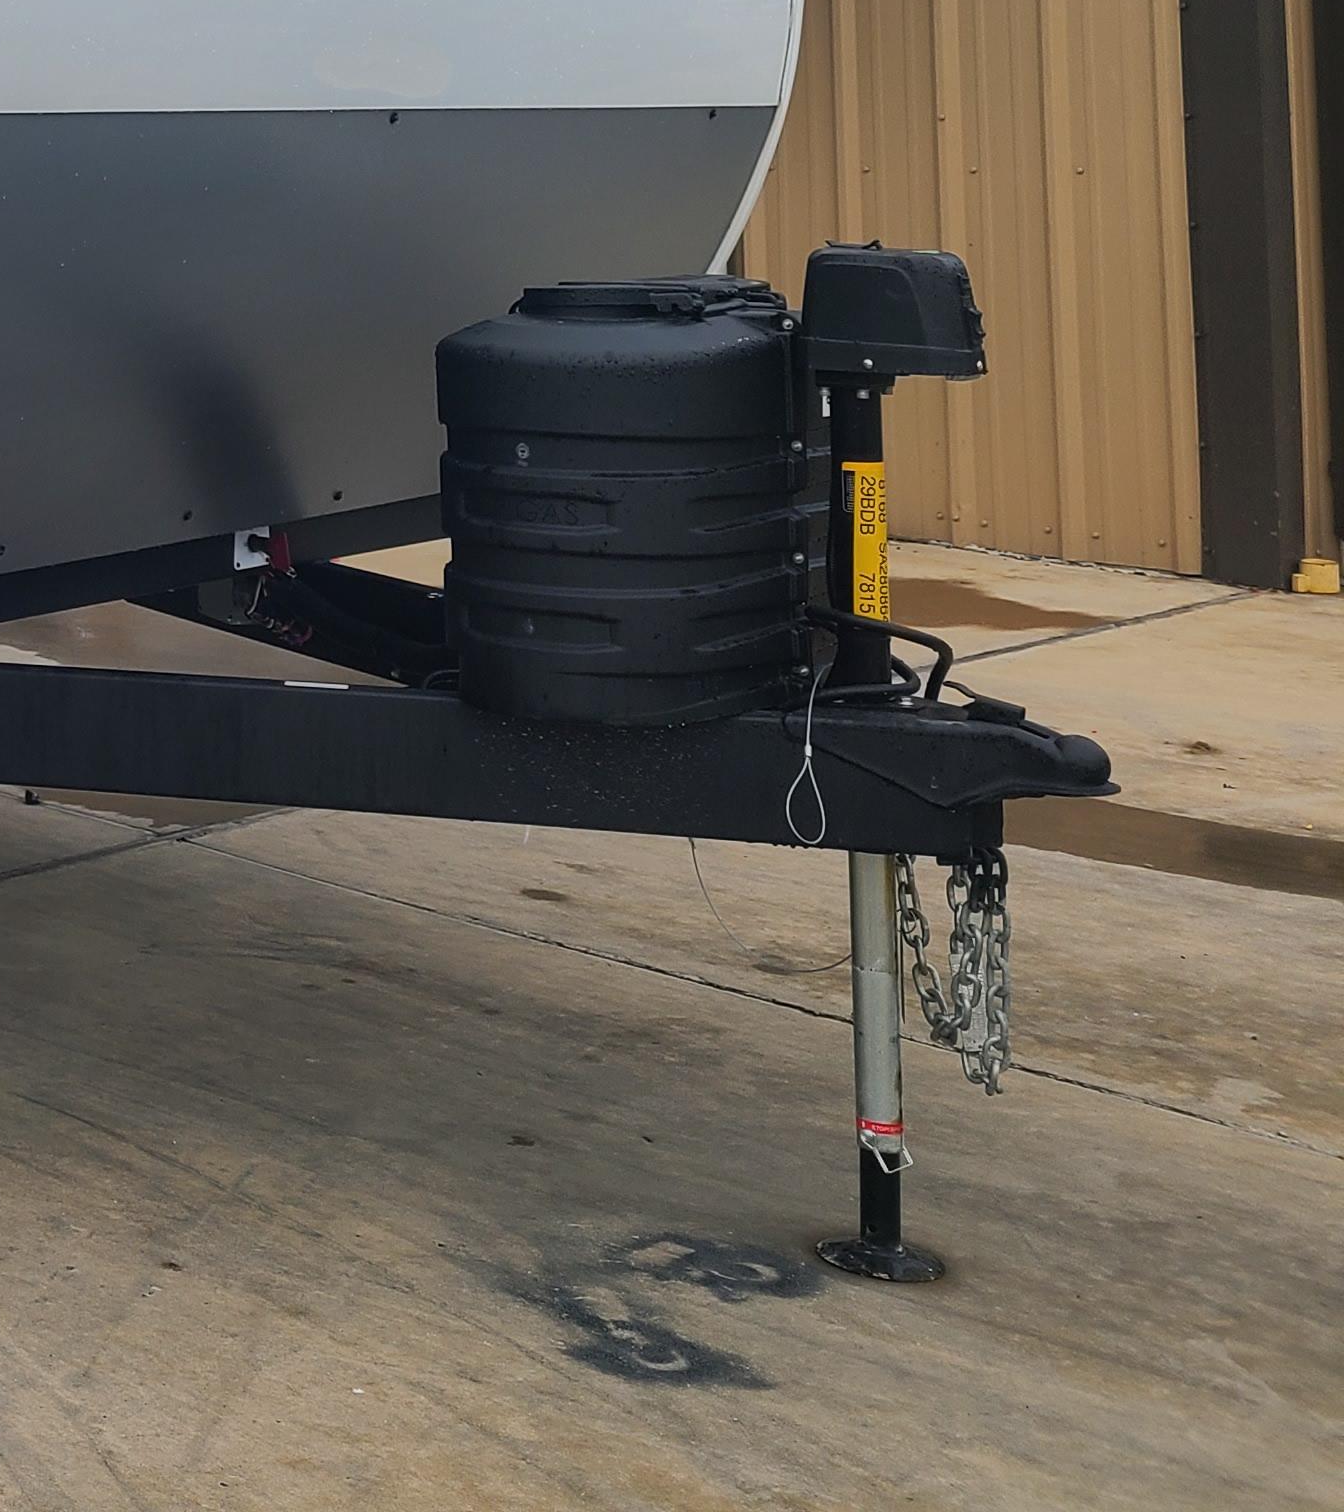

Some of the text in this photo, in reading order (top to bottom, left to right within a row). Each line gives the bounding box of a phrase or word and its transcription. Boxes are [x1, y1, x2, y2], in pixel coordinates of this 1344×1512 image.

[516, 497, 578, 526] GAS
[859, 476, 876, 614] 29BDB 7815
